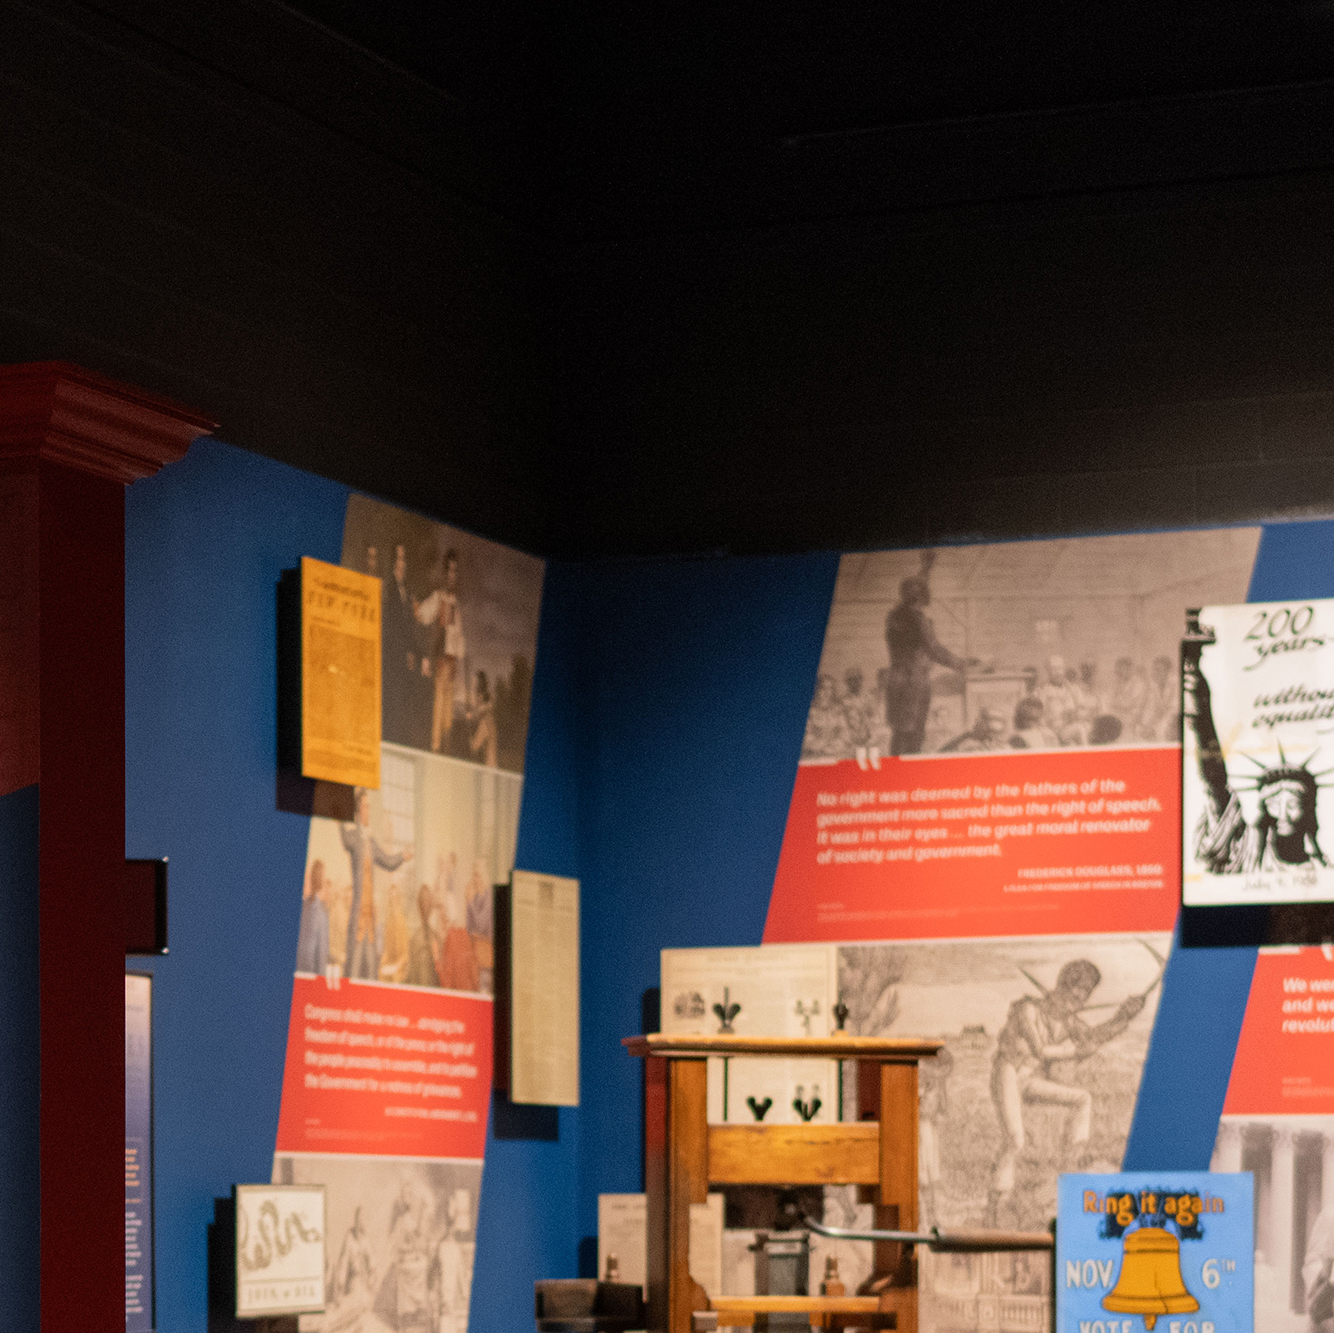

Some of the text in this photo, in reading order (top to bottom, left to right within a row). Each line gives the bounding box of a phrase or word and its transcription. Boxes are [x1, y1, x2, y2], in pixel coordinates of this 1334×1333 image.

[1243, 606, 1314, 642] 200
[1083, 1190, 1225, 1226] Ring it again
